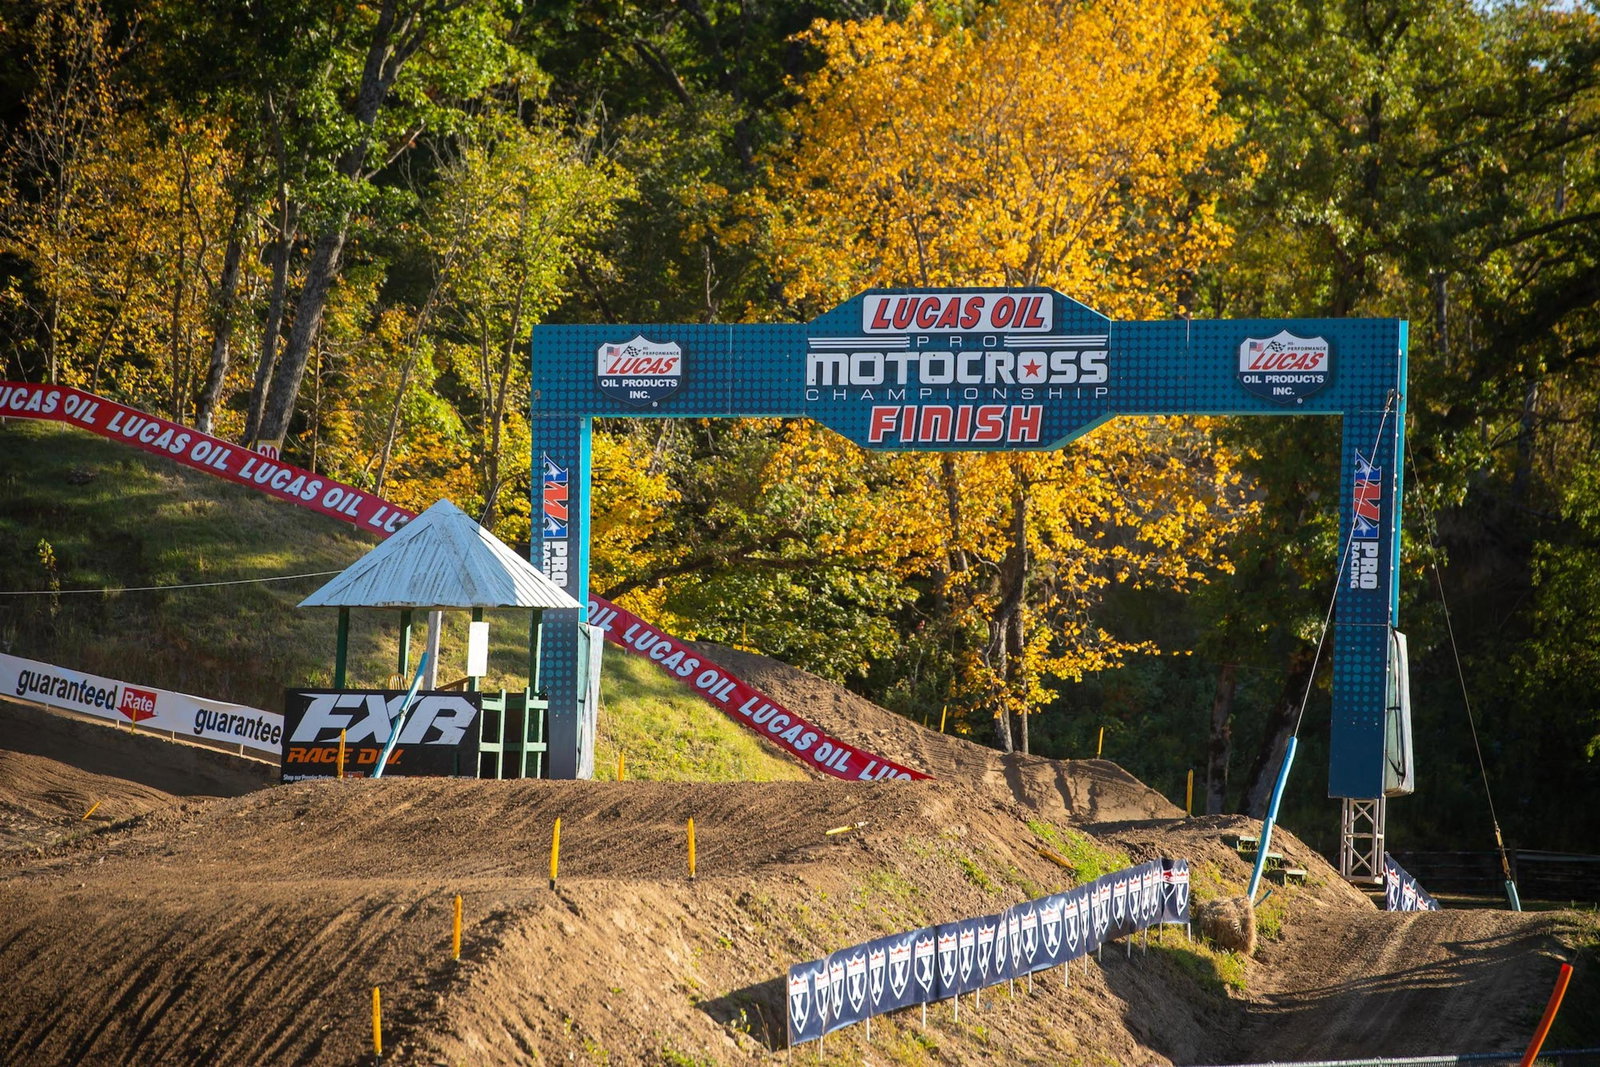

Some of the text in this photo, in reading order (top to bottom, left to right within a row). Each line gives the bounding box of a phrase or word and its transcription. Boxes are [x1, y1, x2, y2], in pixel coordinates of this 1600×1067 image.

[870, 296, 1045, 330] LUCAS OIL
[916, 335, 998, 348] PRO
[606, 357, 680, 374] LUCAS
[806, 350, 1109, 386] MOTOCROSS
[1248, 352, 1325, 370] LUCAS
[601, 379, 678, 388] OIL PRODUCTS
[629, 390, 651, 399] INC.
[806, 387, 1108, 400] CHAMPIONSHIP
[1243, 375, 1324, 384] OIL PRODUCTS
[1272, 387, 1295, 395] INC.
[868, 404, 1044, 443] FINISH
[0, 386, 363, 517] UCAS OIL LUCAS OIL LUCAS OIL
[551, 541, 568, 588] PRO
[1350, 541, 1360, 589] RACING
[1360, 541, 1379, 590] PRO
[16, 669, 118, 710] guaranteed
[123, 691, 154, 712] Rate
[623, 623, 700, 678] LUCAS
[695, 669, 739, 703] OIL
[739, 696, 817, 751] LUCAS
[813, 742, 852, 772] OIL
[193, 707, 284, 746] guarantee
[290, 693, 478, 745] FXR
[287, 748, 350, 764] RACE
